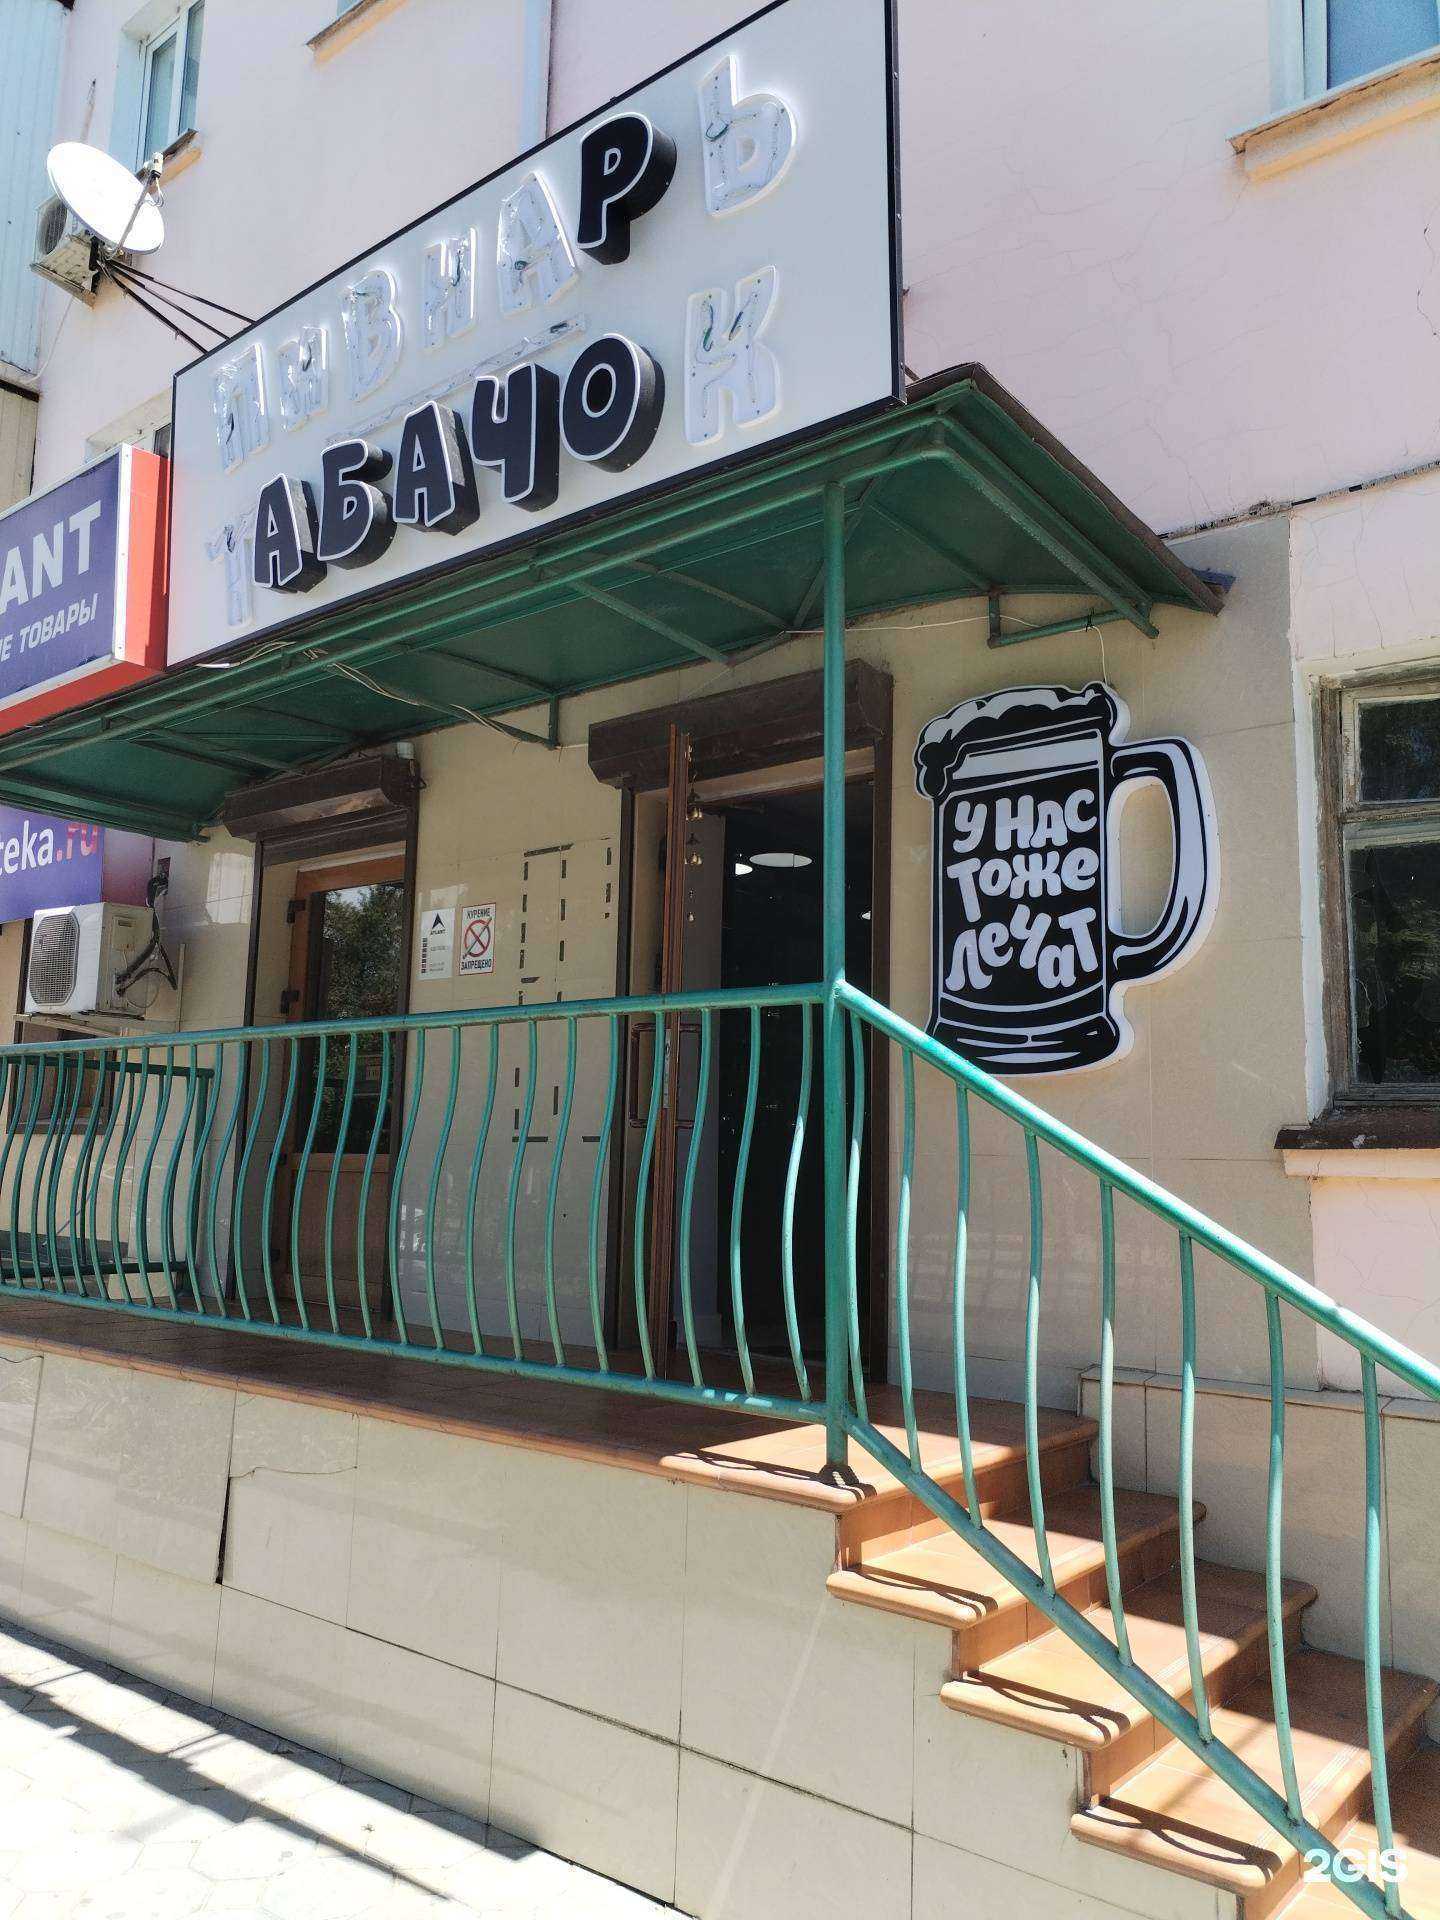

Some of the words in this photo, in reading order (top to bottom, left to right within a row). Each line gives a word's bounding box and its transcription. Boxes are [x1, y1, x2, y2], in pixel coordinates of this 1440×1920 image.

[207, 265, 784, 627] ТАБАЧОК
[19, 592, 99, 654] ТОВАРЫ
[466, 907, 491, 919] КУРЕНИЕ
[461, 958, 492, 971] ЗАПРЕЩЕНО
